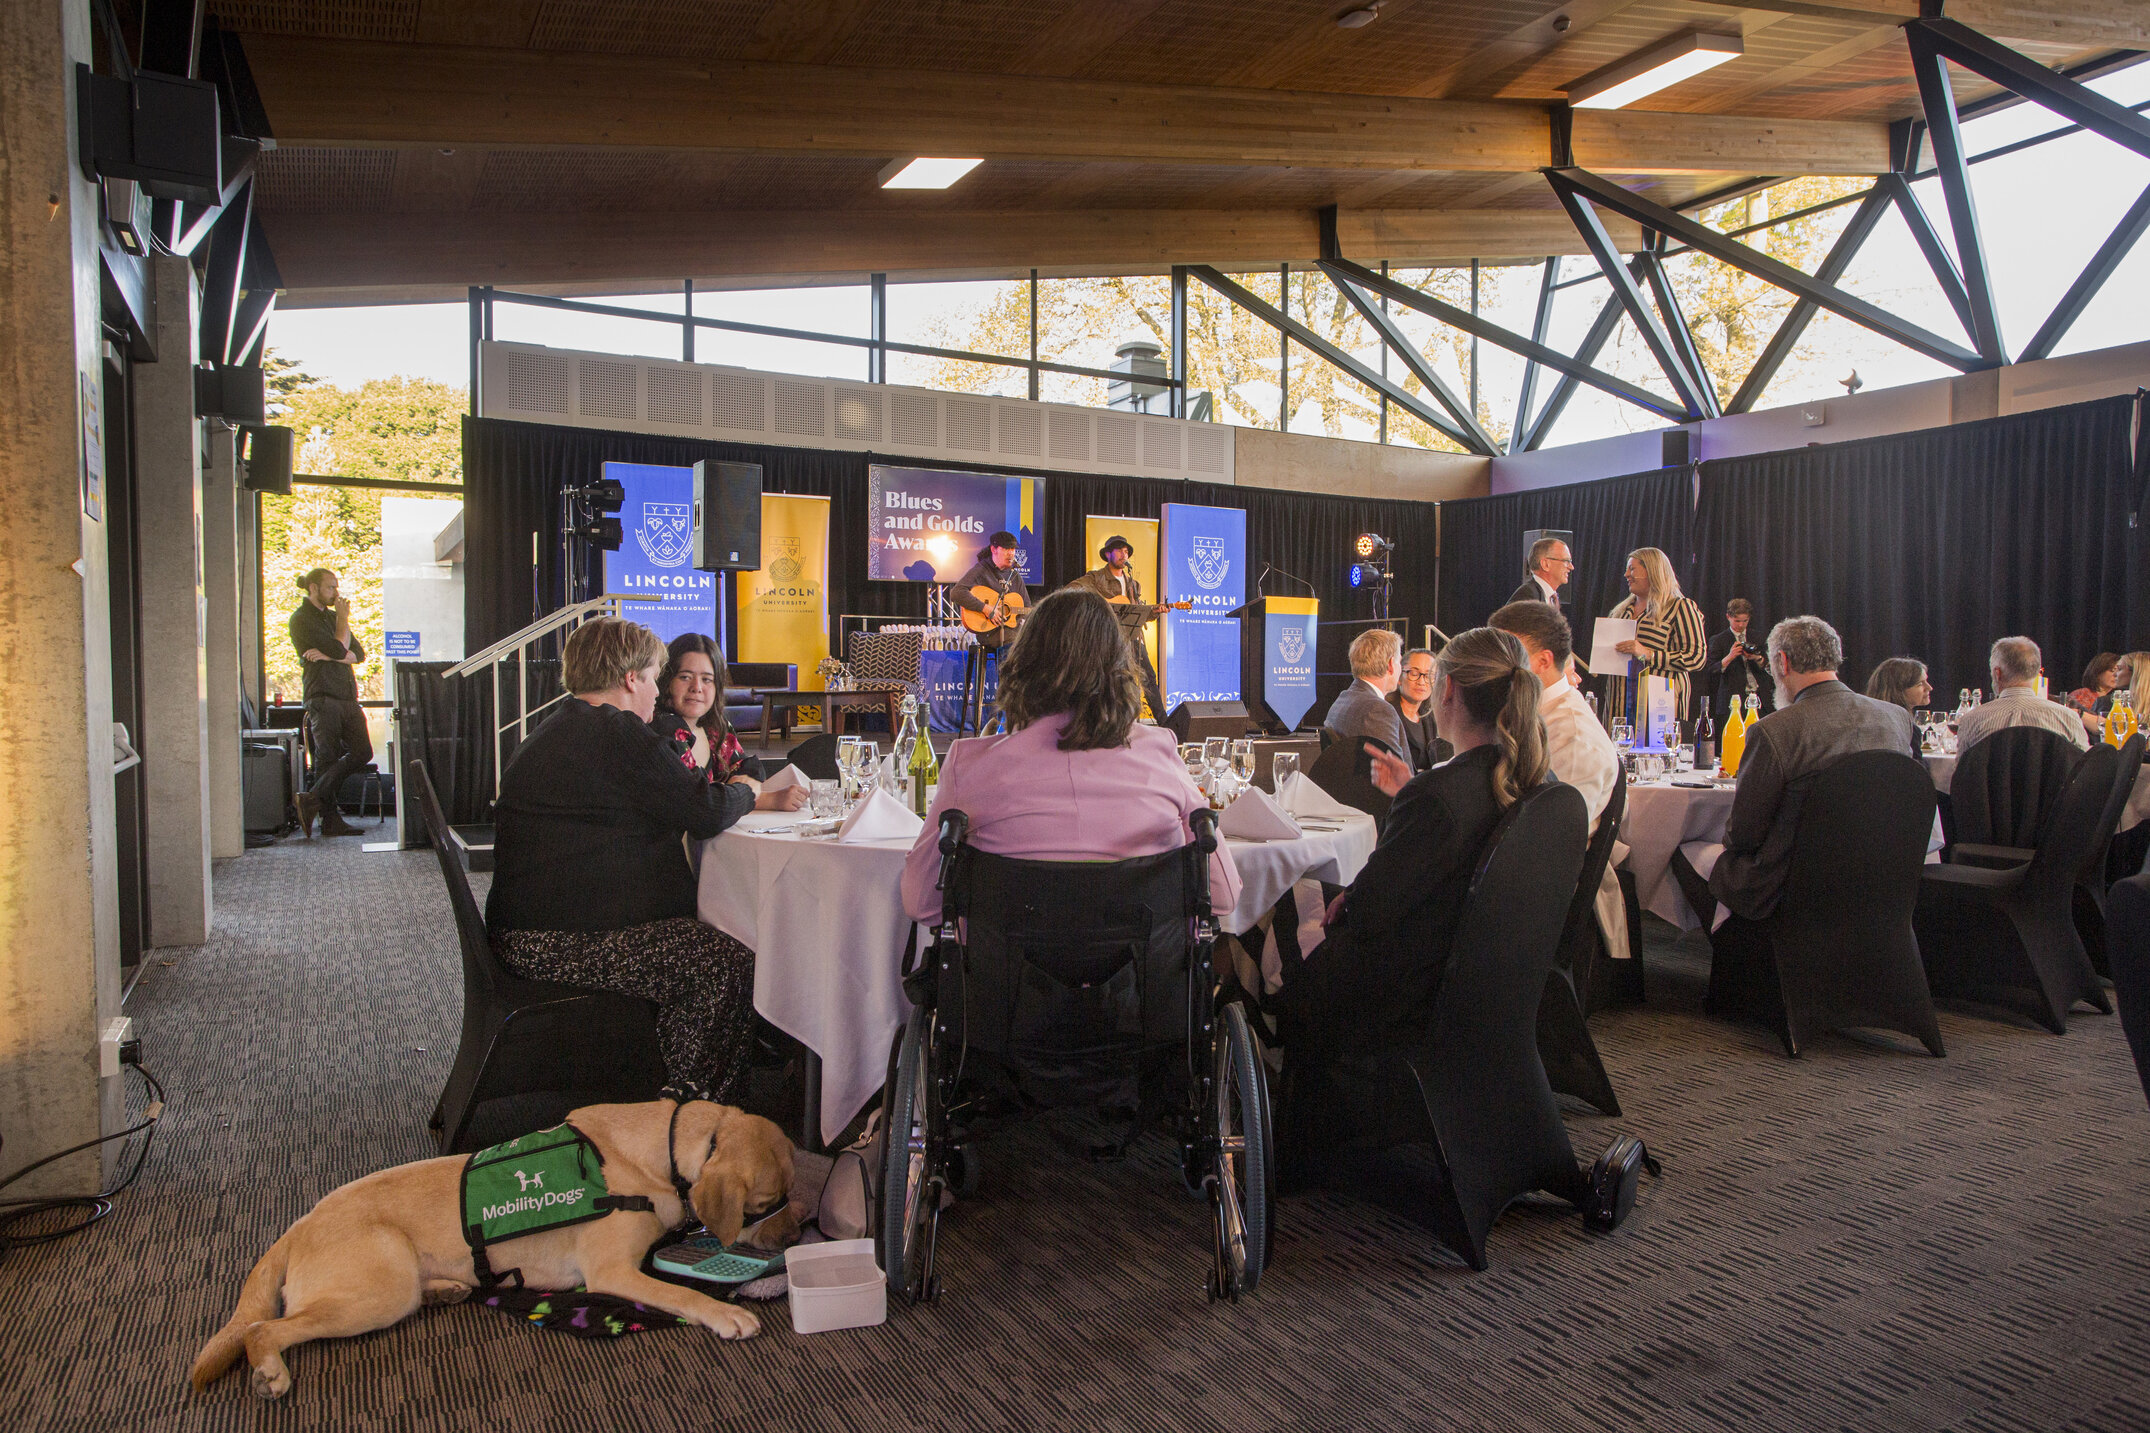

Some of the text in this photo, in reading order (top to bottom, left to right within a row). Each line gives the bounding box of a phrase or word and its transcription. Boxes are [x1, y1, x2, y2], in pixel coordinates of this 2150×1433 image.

[885, 491, 943, 511] Blues
[884, 513, 984, 534] and Golds
[884, 533, 959, 552] Awas
[624, 574, 710, 588] LINCOLN
[755, 587, 815, 596] LINCOLN
[1180, 594, 1236, 606] LINCOLN
[1273, 666, 1311, 674] LINCOLN
